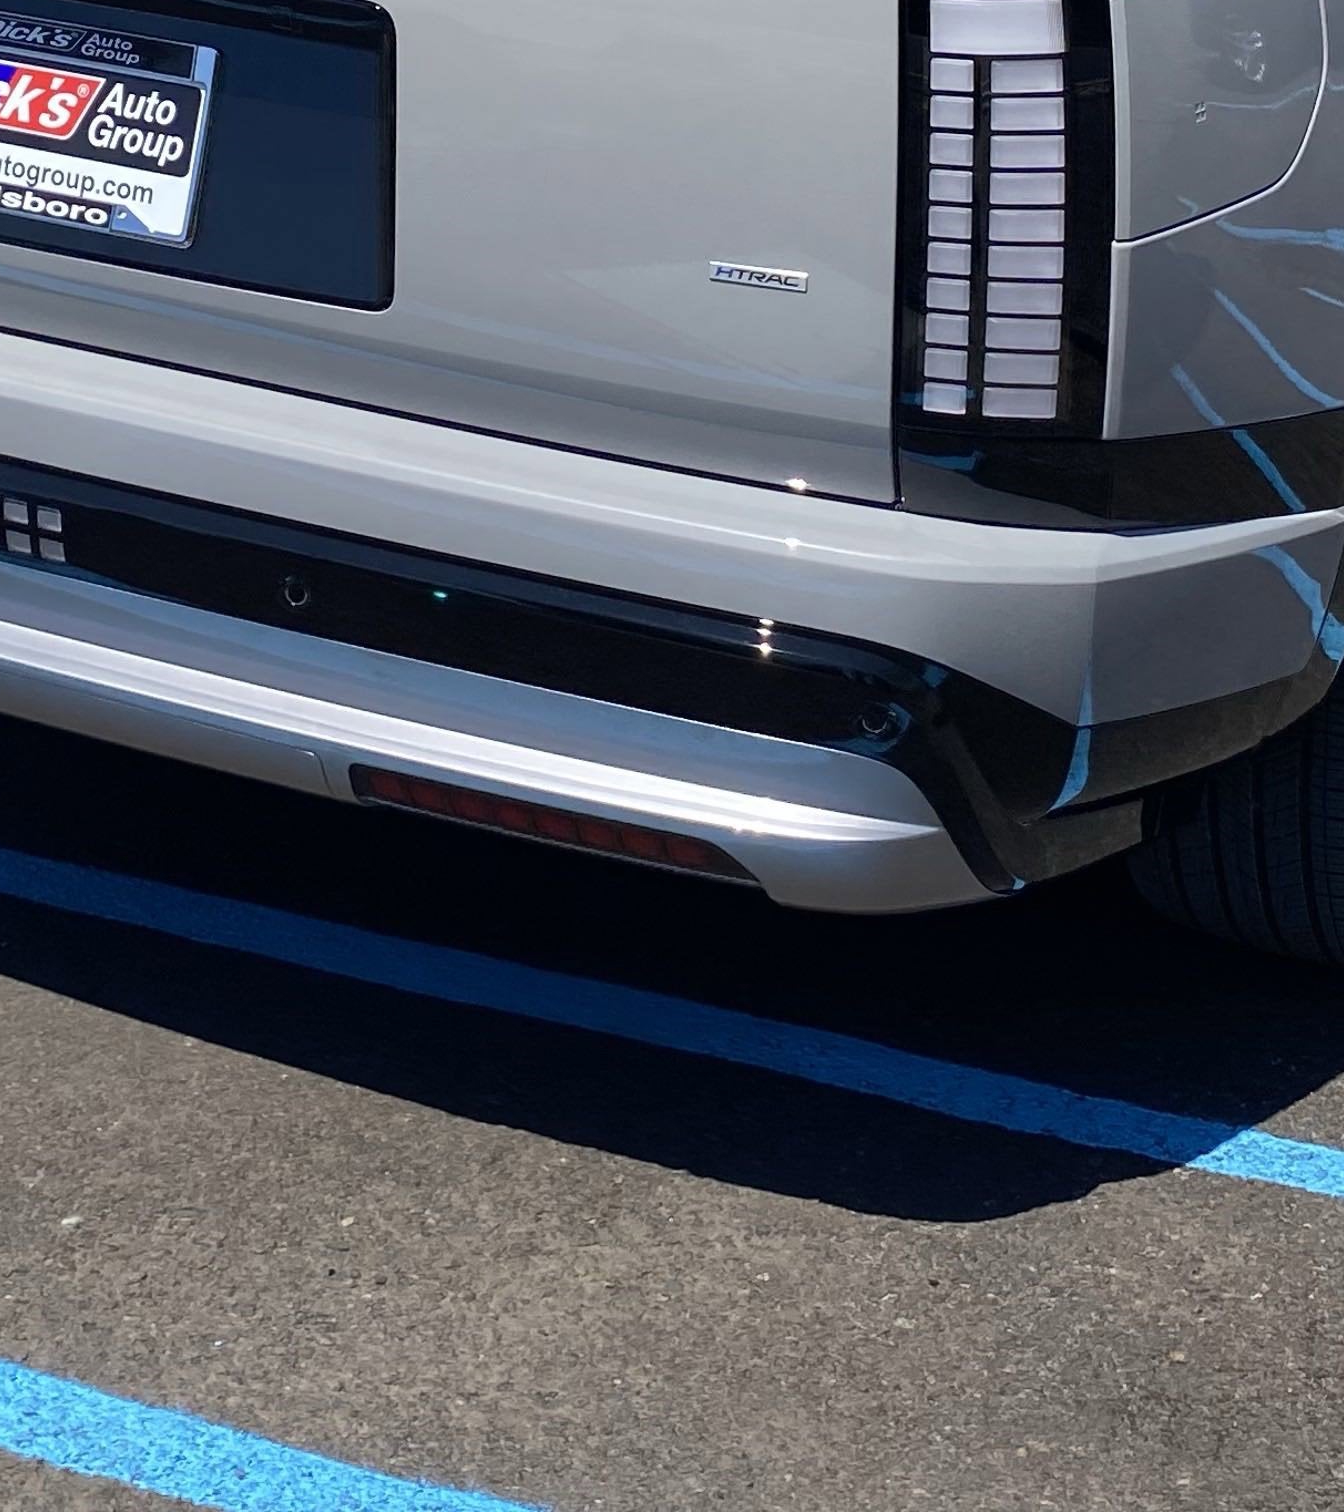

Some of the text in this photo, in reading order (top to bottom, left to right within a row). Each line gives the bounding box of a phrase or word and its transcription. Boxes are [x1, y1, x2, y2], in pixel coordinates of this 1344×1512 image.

[85, 33, 133, 51] Auto
[80, 43, 140, 65] Group
[97, 82, 177, 126] Auto
[88, 115, 184, 168] Group
[715, 267, 799, 288] HTRAC
